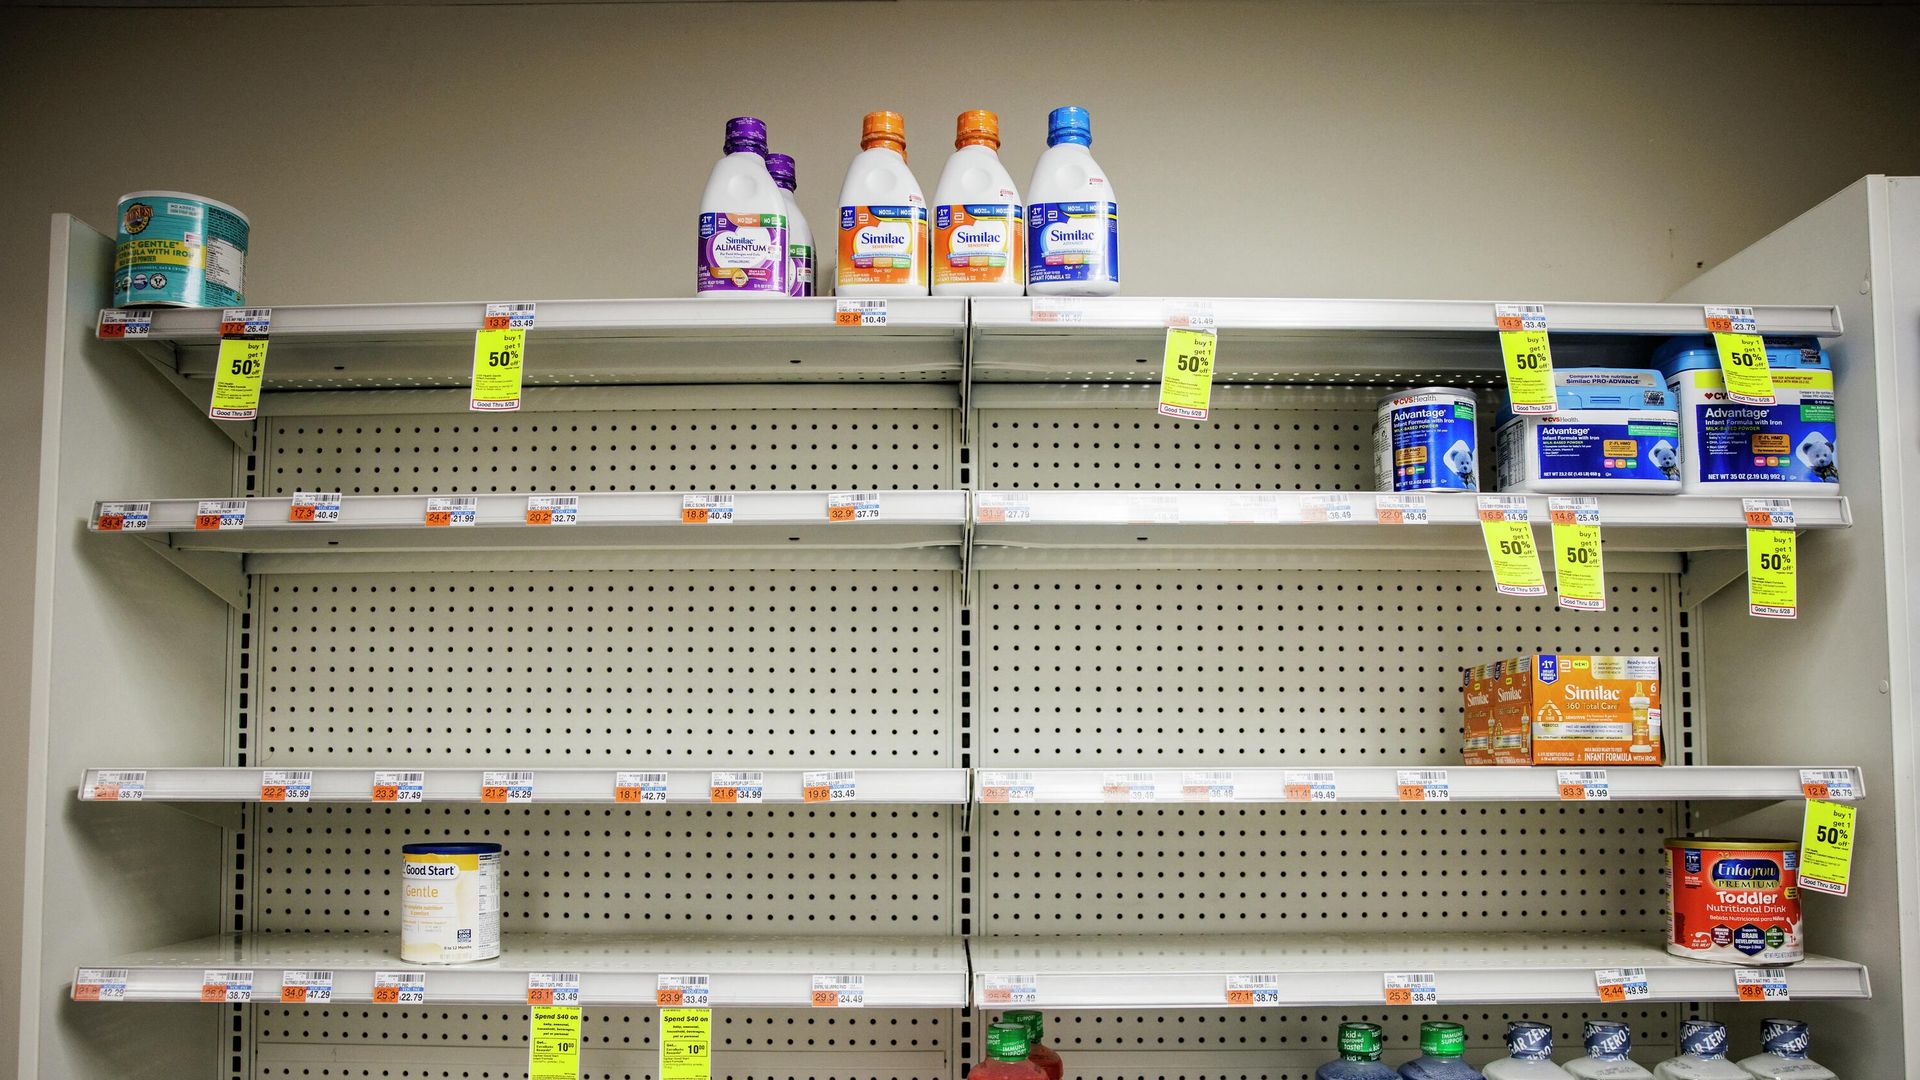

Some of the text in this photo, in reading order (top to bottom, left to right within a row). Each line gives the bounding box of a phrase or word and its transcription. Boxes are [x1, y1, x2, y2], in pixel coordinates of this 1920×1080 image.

[861, 233, 904, 244] Similac
[957, 232, 1000, 243] Similac
[1051, 230, 1094, 241] Similac
[1194, 339, 1206, 347] buy
[1565, 684, 1620, 700] Similac
[1650, 683, 1656, 692] 6
[1467, 692, 1489, 706] Similac
[1497, 686, 1522, 703] Similac
[1585, 753, 1605, 761] INFANT
[1606, 753, 1632, 761] FORMULA
[1833, 810, 1845, 819] buy
[406, 865, 454, 876] Good Start
[1718, 864, 1776, 878] Enfagrow
[1718, 880, 1775, 888] PREMIUM
[405, 884, 439, 897] Gentle
[1716, 891, 1778, 904] Toddler
[1707, 904, 1762, 913] Nutritional
[1600, 1030, 1627, 1052] ZERO
[1703, 1026, 1726, 1051] ZERO
[1783, 1033, 1808, 1052] ZERO
[1003, 1043, 1025, 1052] IMMUNE
